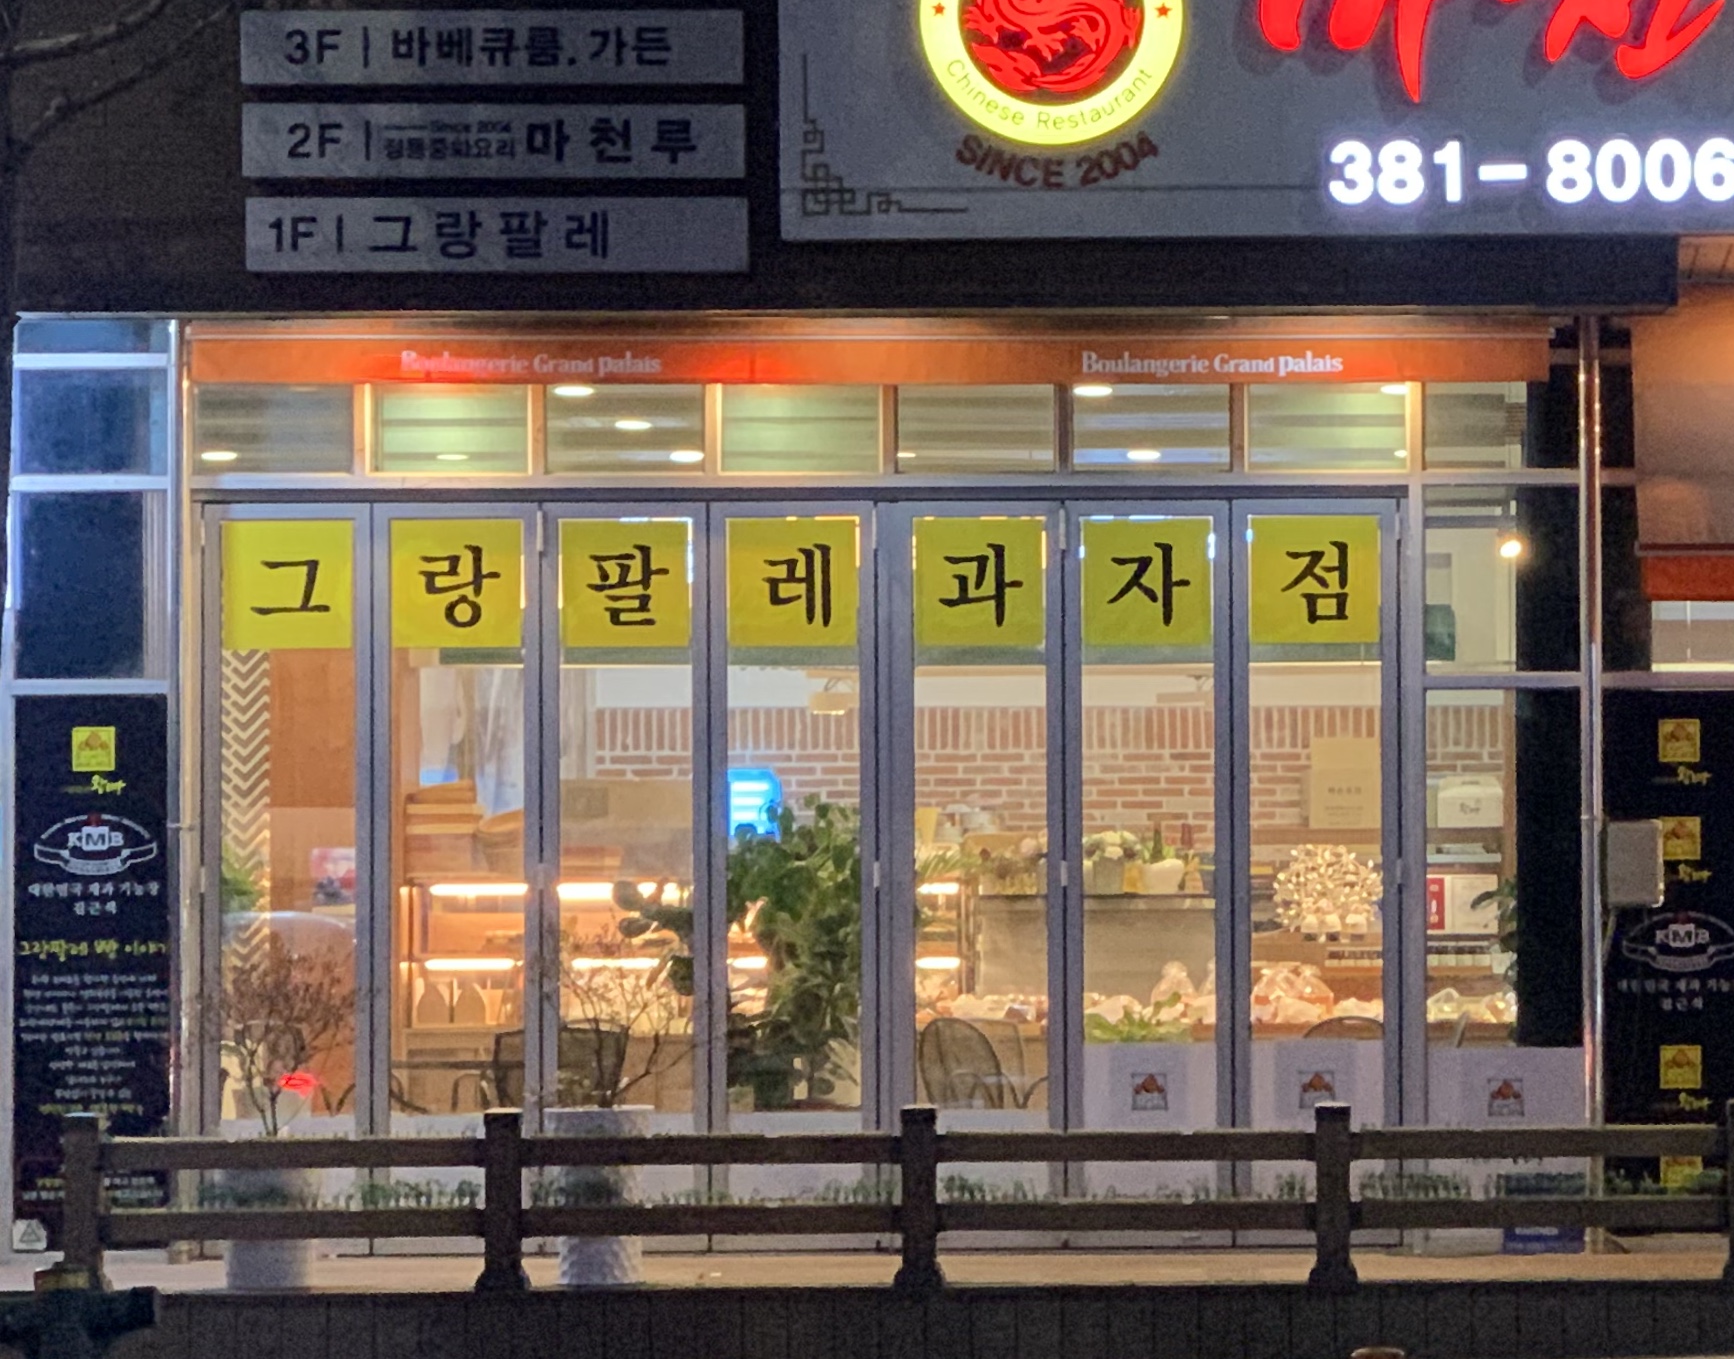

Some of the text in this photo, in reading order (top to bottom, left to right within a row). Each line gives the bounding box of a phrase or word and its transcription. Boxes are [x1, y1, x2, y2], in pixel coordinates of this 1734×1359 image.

[283, 28, 342, 65] 3F
[946, 56, 1155, 132] Chinese Restaurant
[286, 122, 343, 159] 2F
[525, 117, 699, 164] 마천루
[955, 130, 1159, 190] SINCE 2004
[268, 210, 609, 260] 1F 그랑팔레
[532, 353, 594, 374] Grand
[1082, 351, 1209, 377] Boulangerie
[1213, 353, 1274, 373] Grand
[67, 830, 125, 849] KMB
